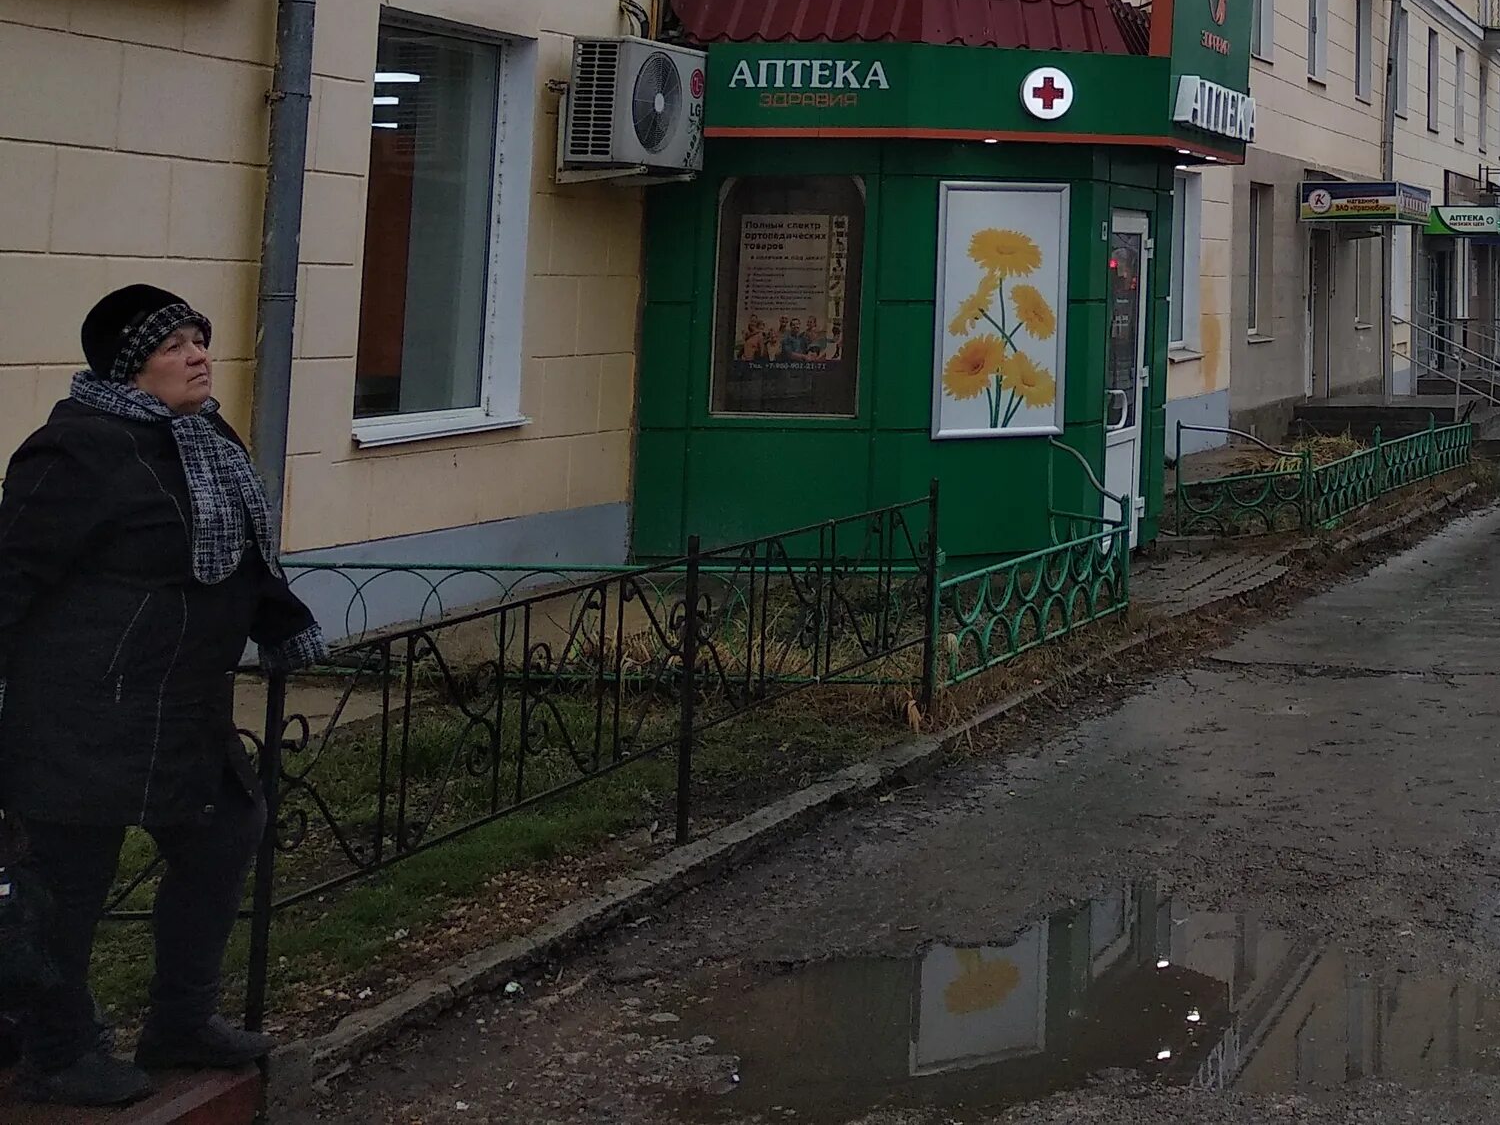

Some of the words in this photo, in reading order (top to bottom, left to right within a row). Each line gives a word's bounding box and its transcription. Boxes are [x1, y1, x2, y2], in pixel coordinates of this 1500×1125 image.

[728, 59, 890, 89] АПТЕКА
[759, 92, 857, 108] ЗДРАВИЯ
[690, 103, 702, 117] LG
[1175, 75, 1256, 142] АПТЕКА
[745, 221, 784, 229] Полный
[787, 222, 821, 230] спектр
[1449, 214, 1485, 222] АПТЕКА
